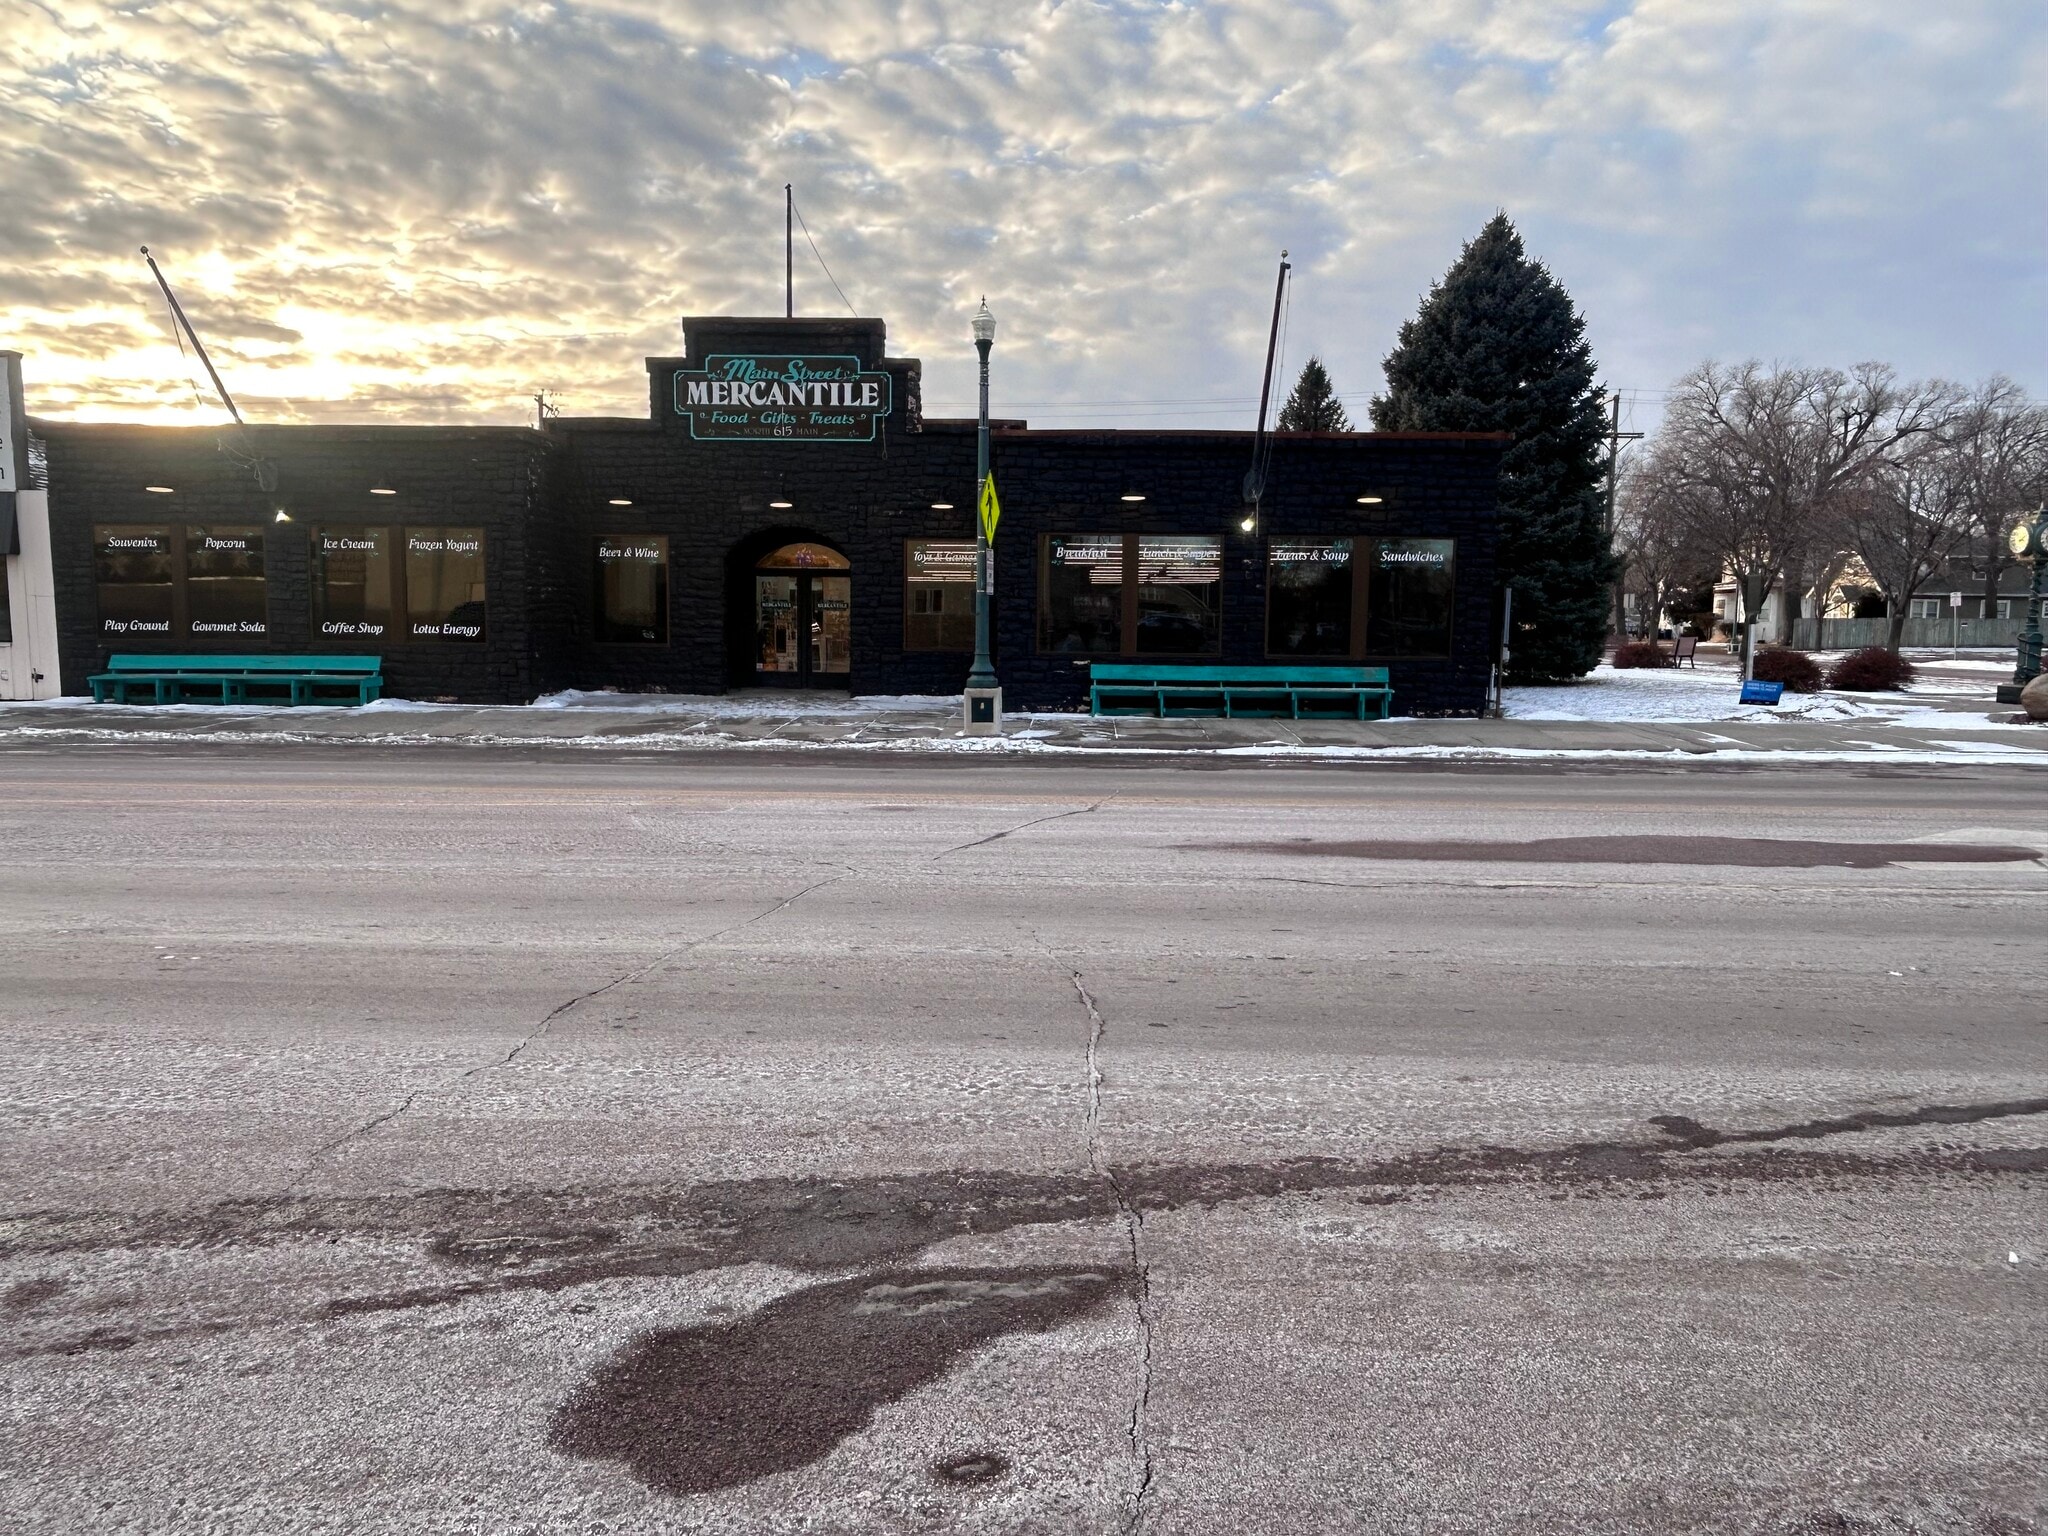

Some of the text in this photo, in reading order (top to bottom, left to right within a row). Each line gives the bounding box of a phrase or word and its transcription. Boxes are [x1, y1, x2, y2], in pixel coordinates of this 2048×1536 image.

[723, 359, 842, 386] Main Street
[686, 381, 879, 408] MERCANTILE
[711, 411, 748, 424] Food
[760, 411, 797, 426] Gifts
[809, 411, 855, 424] Treats
[743, 427, 770, 435] NORTH
[773, 425, 793, 436] 615
[108, 536, 158, 547] Souvenirs
[205, 537, 246, 550] Popcorn
[323, 538, 375, 549] Ice Cream
[409, 538, 479, 553] Frozen Yogurt
[599, 547, 659, 558] Beer & Wine
[1056, 546, 1108, 559] Breakfast
[1310, 549, 1319, 561] &
[1321, 549, 1349, 563] Soup
[1380, 550, 1444, 562] Sandwiches
[104, 620, 169, 633] Play Ground
[192, 620, 266, 632] Gourmet Soda
[322, 621, 383, 635] Coffee Shop
[413, 623, 480, 637] Lotus Energy
